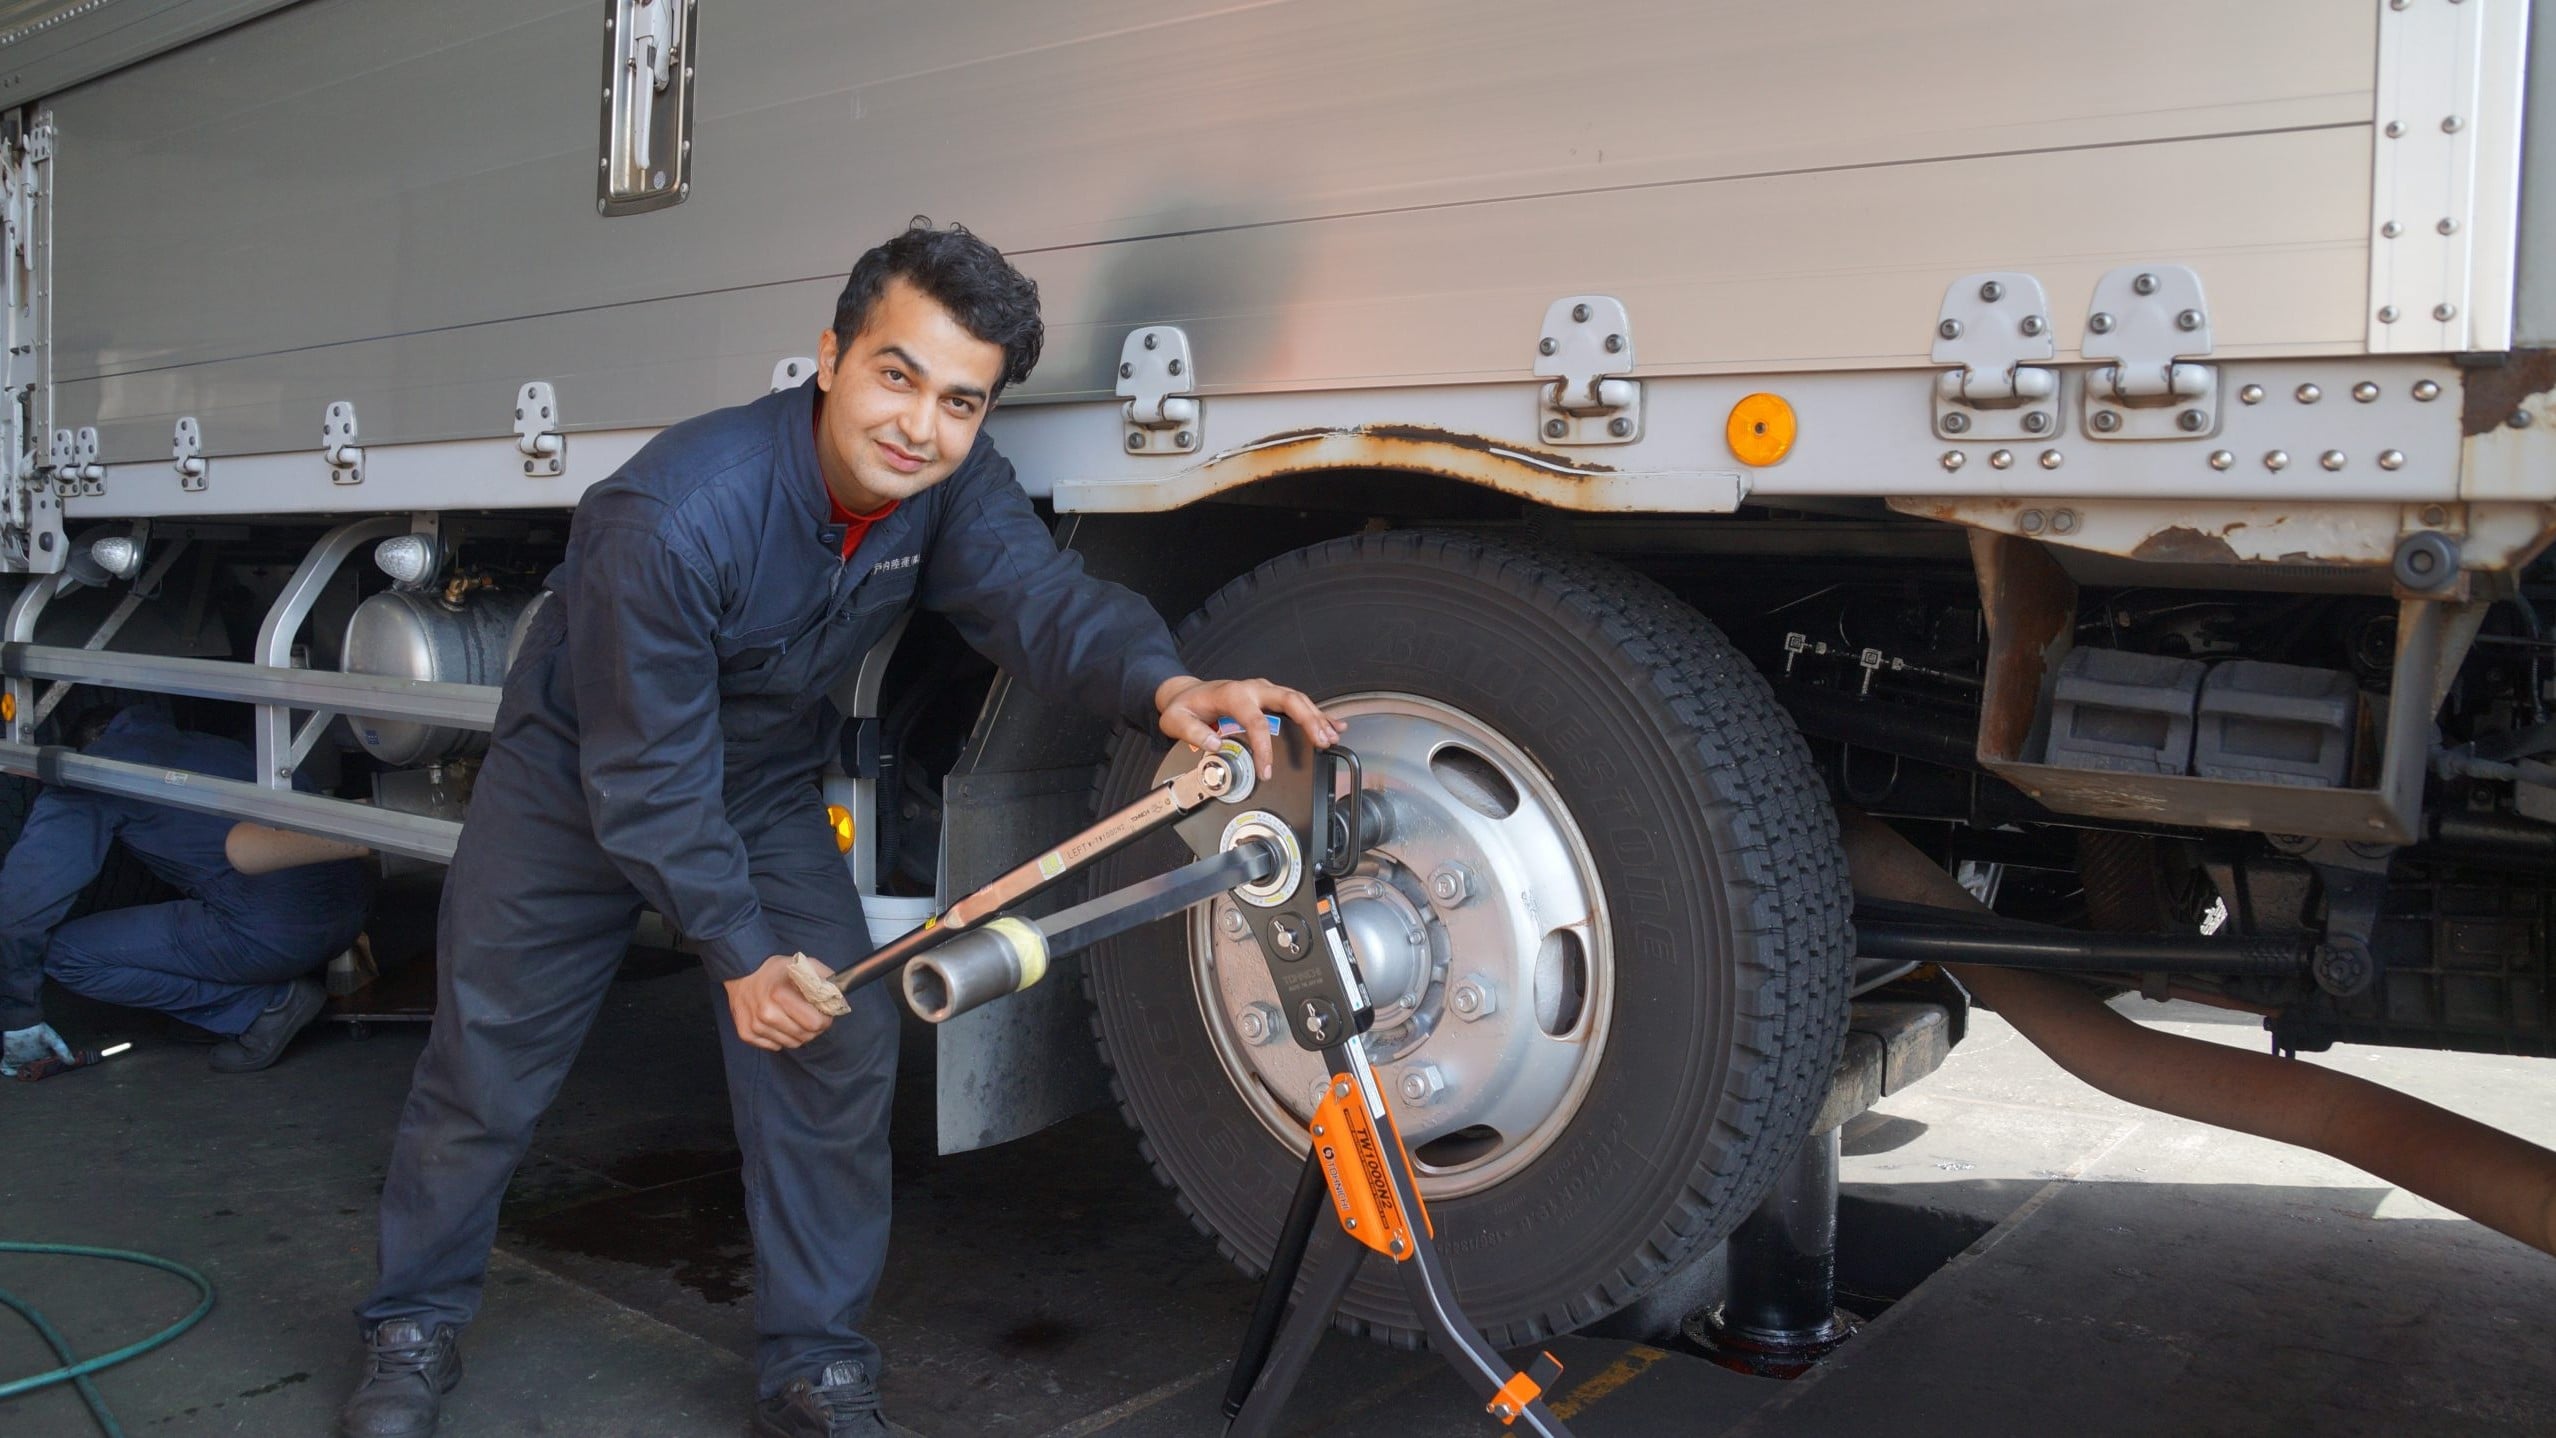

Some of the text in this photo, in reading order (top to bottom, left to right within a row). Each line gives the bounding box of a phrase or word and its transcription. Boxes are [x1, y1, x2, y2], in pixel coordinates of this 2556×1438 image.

[1366, 616, 1678, 966] BRIDGESTONE
[1067, 843, 1087, 859] LEFT
[1327, 1162, 1350, 1210] TOHNICHI
[1358, 1127, 1392, 1209] TW1000N2
